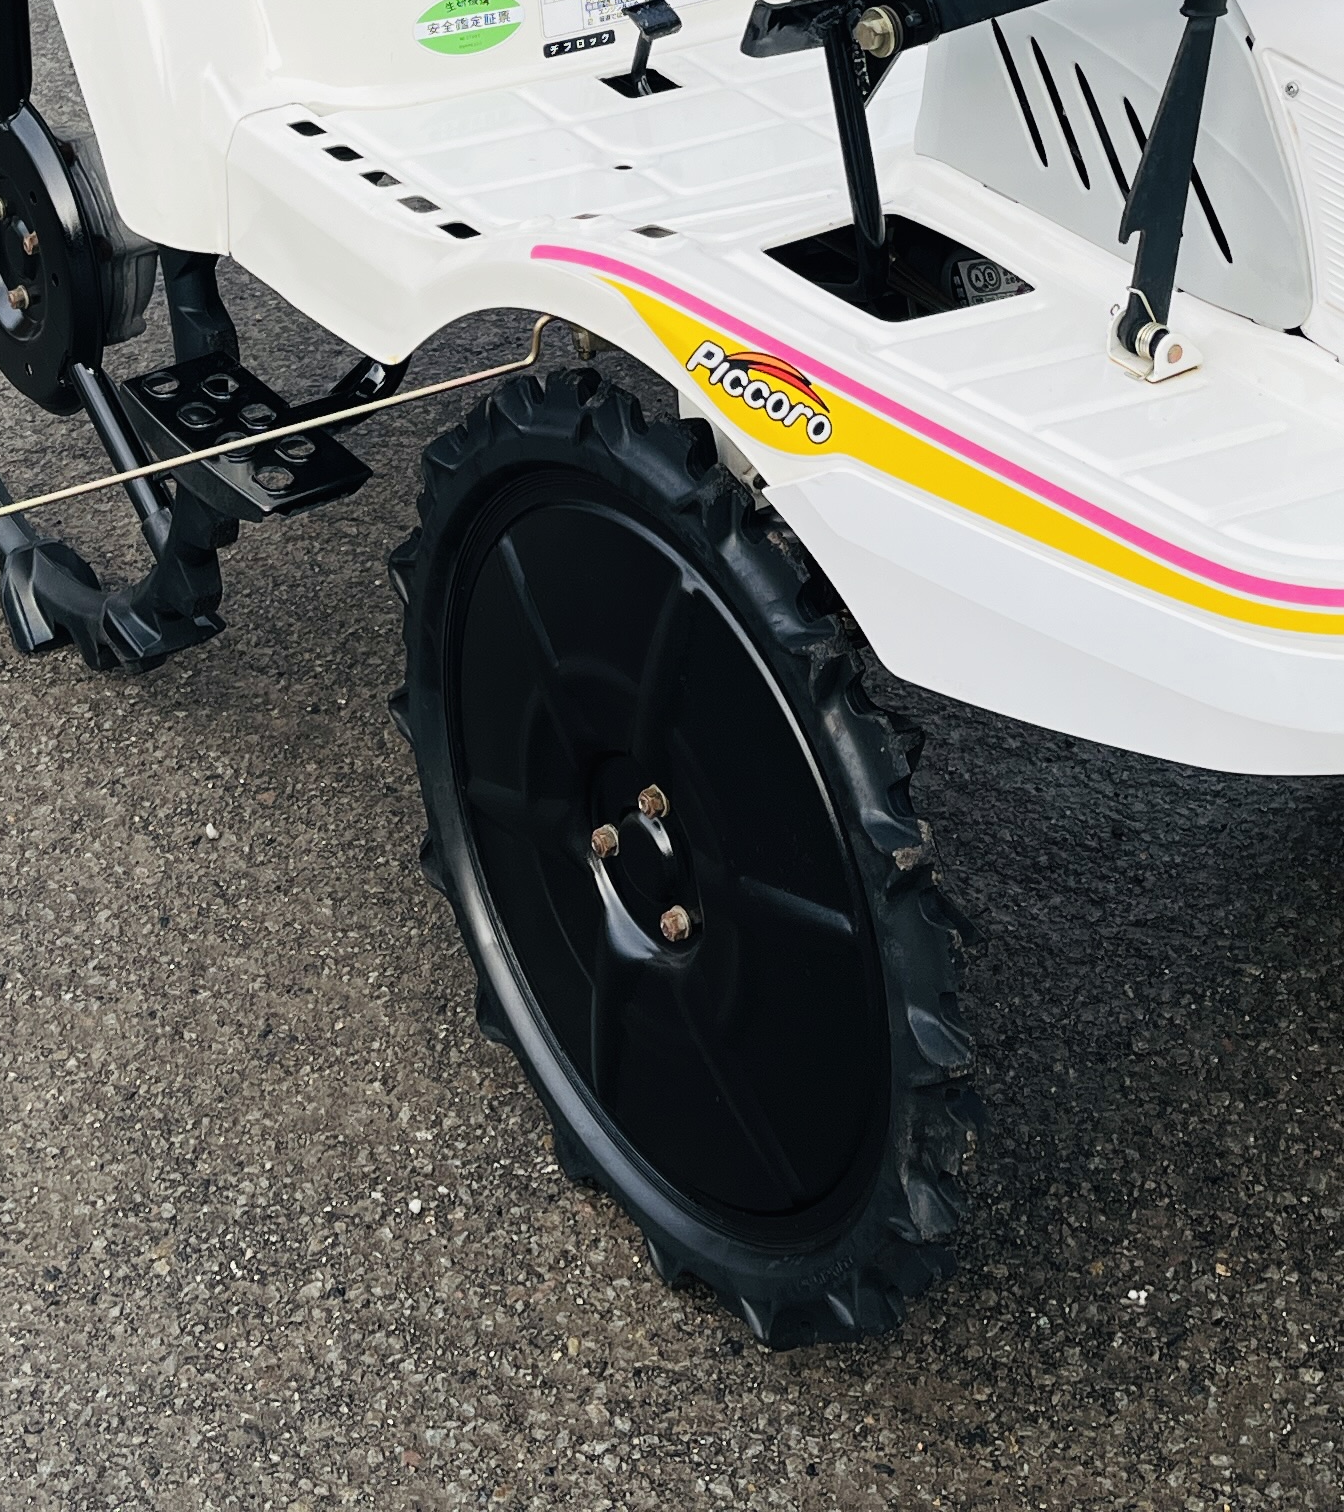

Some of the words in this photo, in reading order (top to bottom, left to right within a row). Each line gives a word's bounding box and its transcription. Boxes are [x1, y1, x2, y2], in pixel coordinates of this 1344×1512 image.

[549, 33, 610, 55] デフロック
[685, 339, 833, 444] Piccoro
